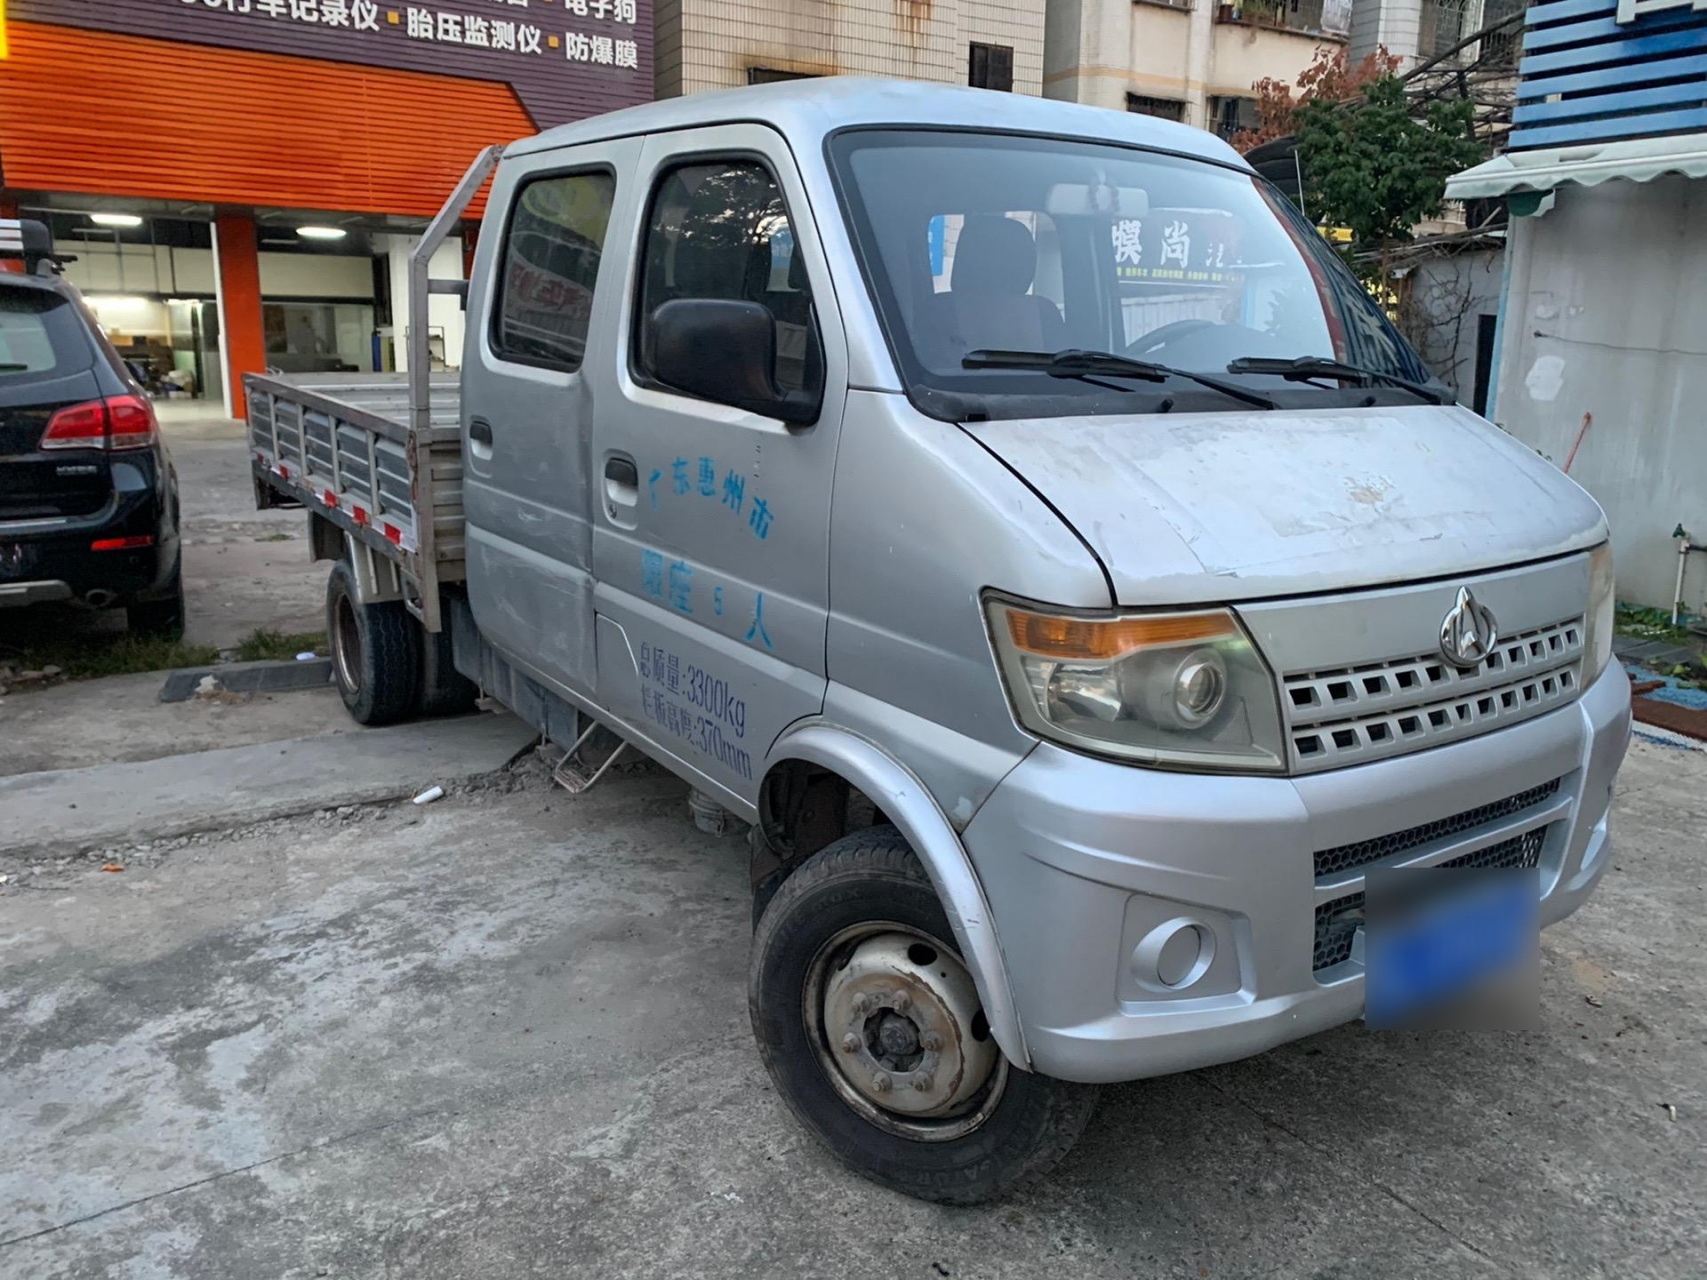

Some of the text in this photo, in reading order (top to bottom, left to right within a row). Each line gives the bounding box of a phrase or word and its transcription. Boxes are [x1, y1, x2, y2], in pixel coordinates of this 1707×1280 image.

[406, 7, 542, 55] 胎压监测仪
[565, 32, 639, 69] 防爆膜
